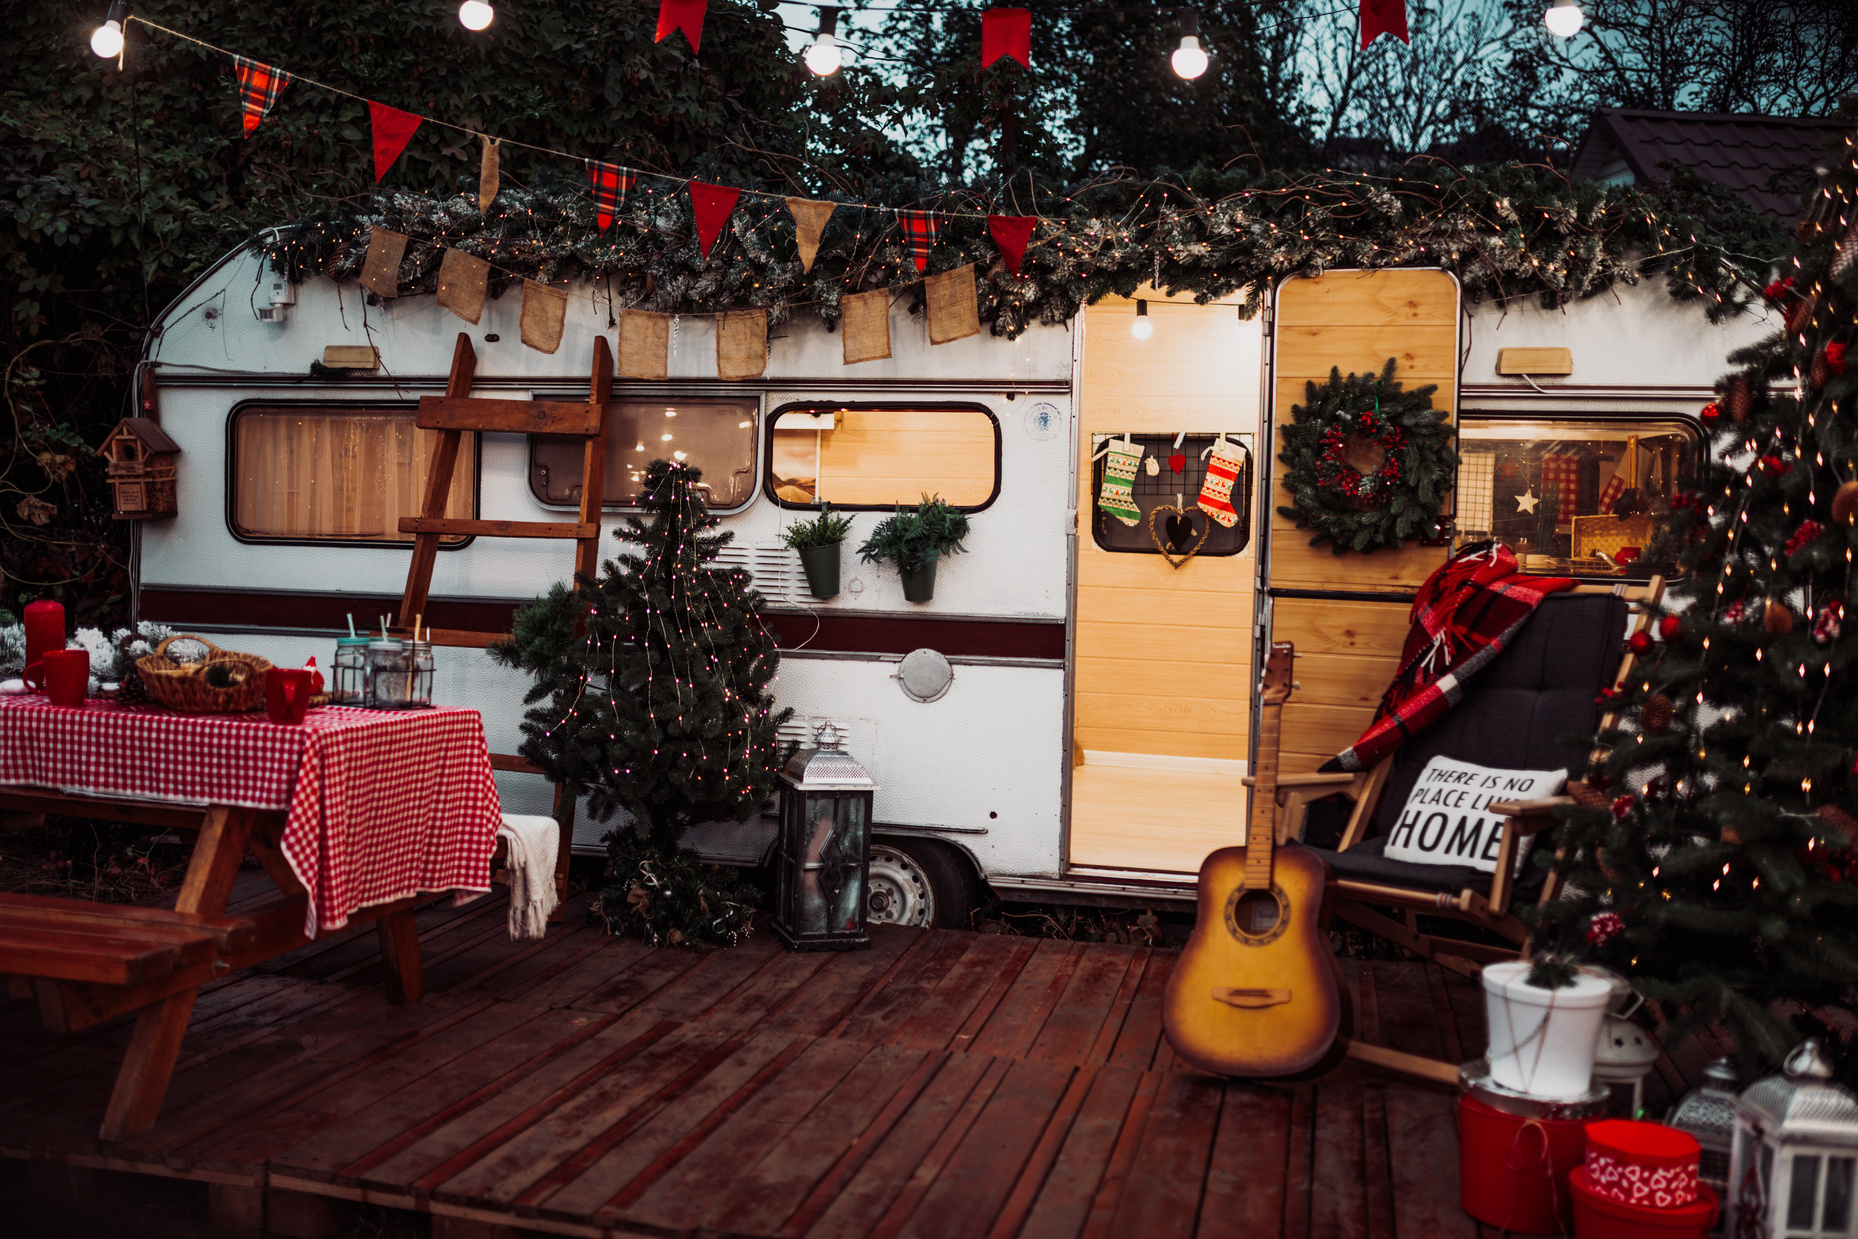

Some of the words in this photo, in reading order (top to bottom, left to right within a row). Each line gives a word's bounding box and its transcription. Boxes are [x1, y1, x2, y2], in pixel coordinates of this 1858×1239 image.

[1426, 768, 1480, 786] THERE
[1480, 775, 1502, 789] IS
[1503, 778, 1535, 793] NO
[1410, 787, 1471, 809] PLACE
[1470, 793, 1520, 811] LI
[1391, 809, 1505, 861] HOME
